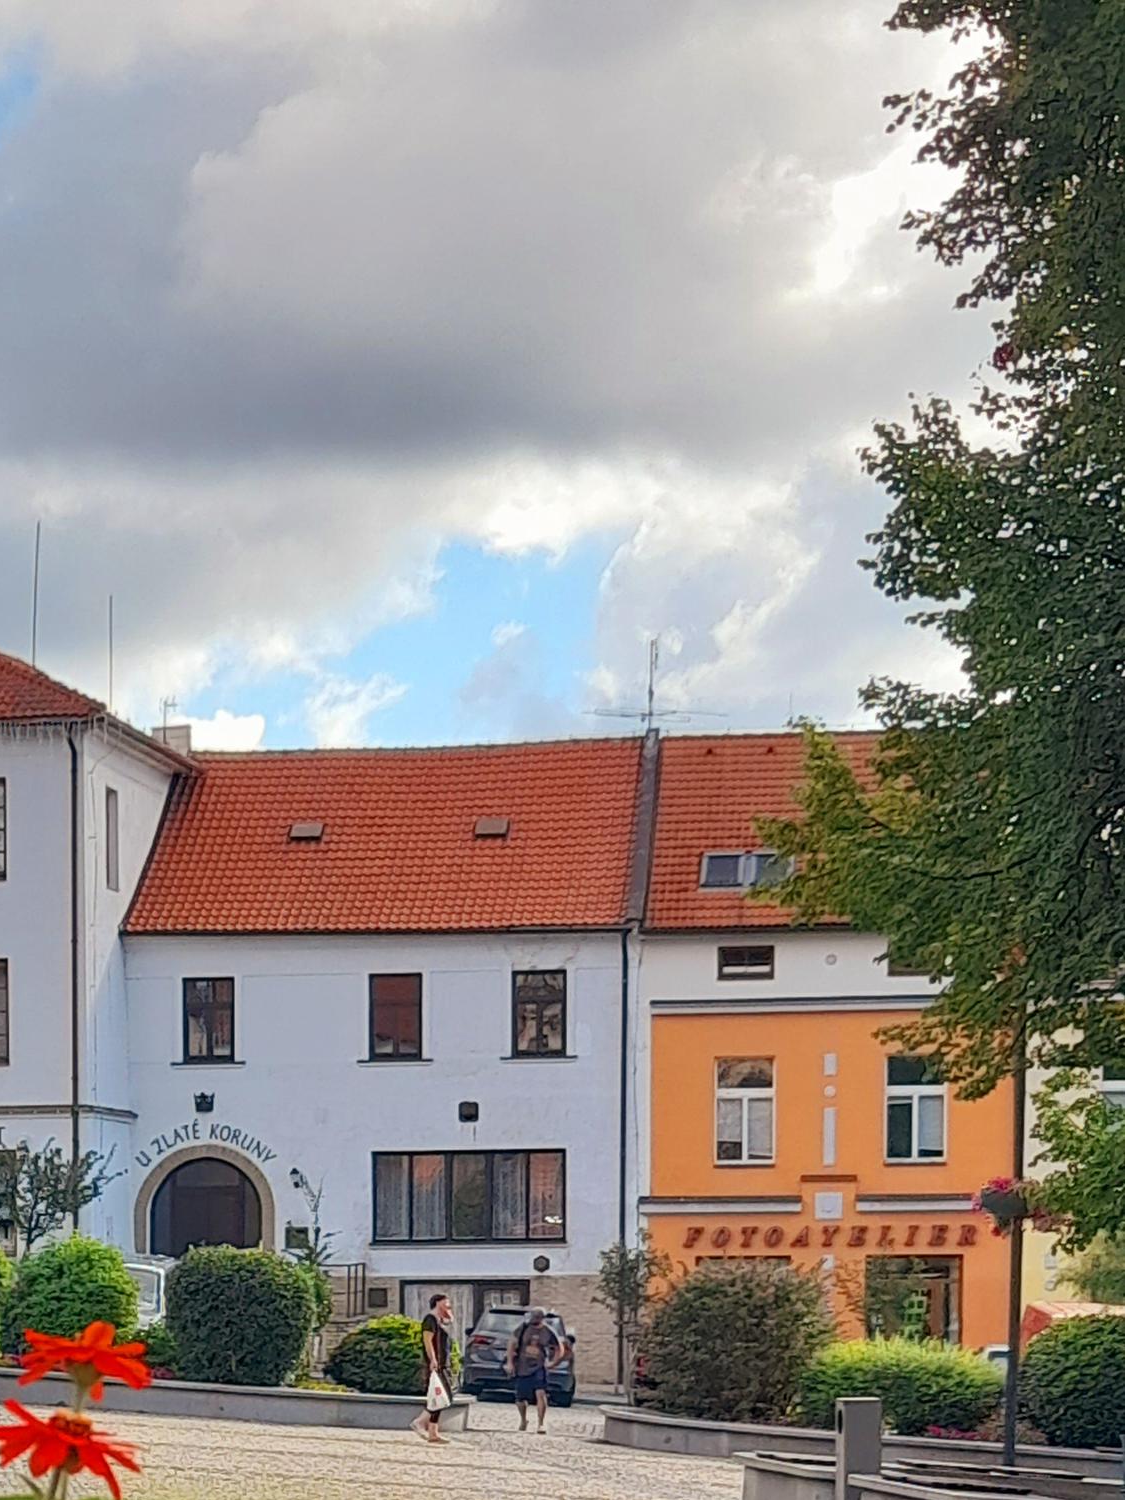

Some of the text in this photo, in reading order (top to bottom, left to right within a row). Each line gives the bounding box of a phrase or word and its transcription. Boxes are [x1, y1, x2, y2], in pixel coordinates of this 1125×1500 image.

[135, 1119, 277, 1167] U ZLATÉ KORUNY
[683, 1225, 978, 1248] FOTOATELIER
